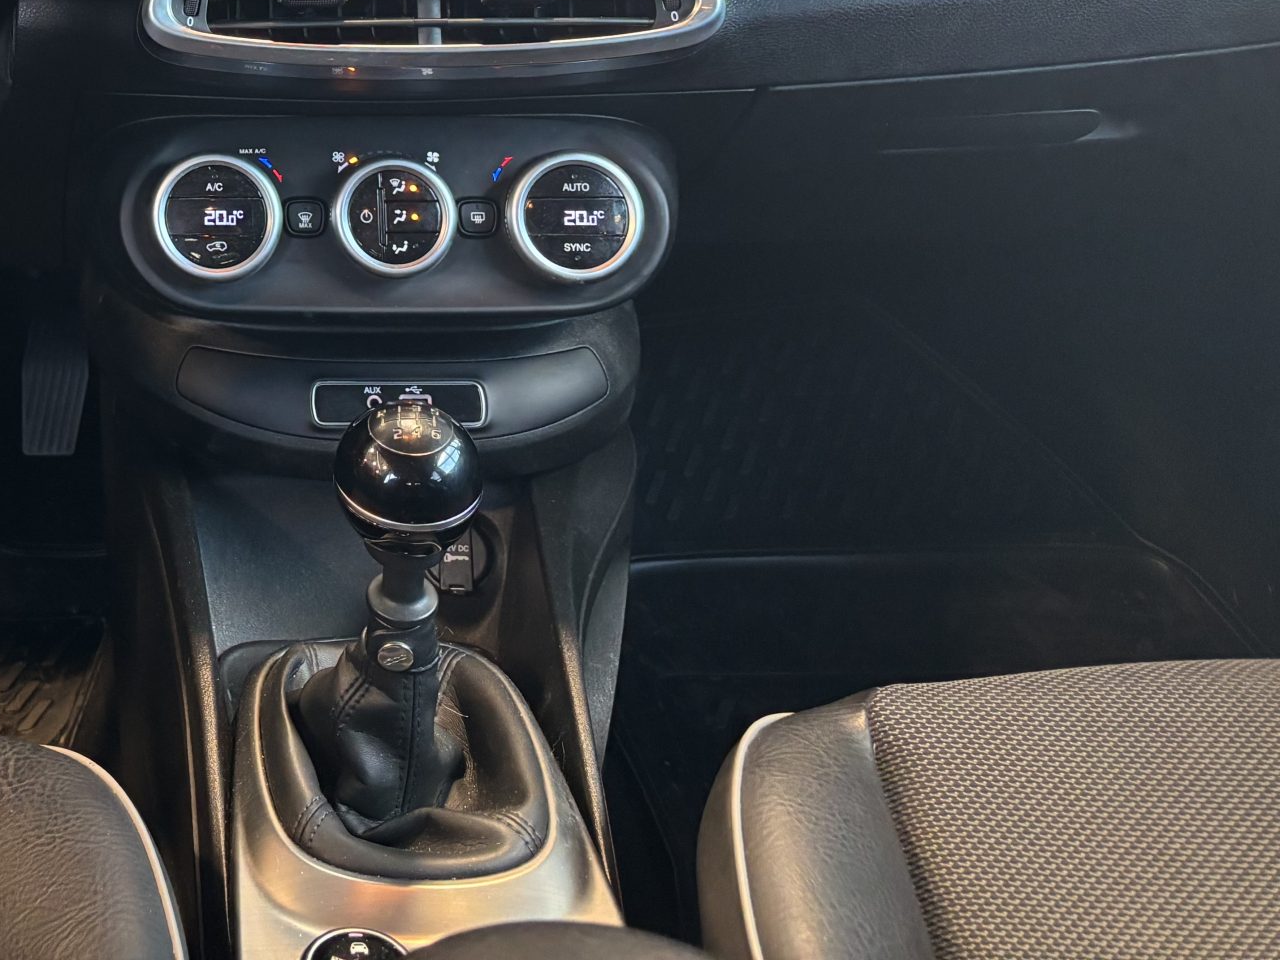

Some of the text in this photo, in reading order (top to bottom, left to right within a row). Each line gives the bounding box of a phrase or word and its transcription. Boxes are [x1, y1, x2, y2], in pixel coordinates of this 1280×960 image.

[205, 182, 224, 192] A/C
[562, 182, 590, 192] AUTO
[563, 242, 592, 252] SYNC
[363, 386, 382, 394] AUX
[393, 428, 403, 439] 2
[431, 429, 442, 439] 6
[458, 544, 470, 552] DC
